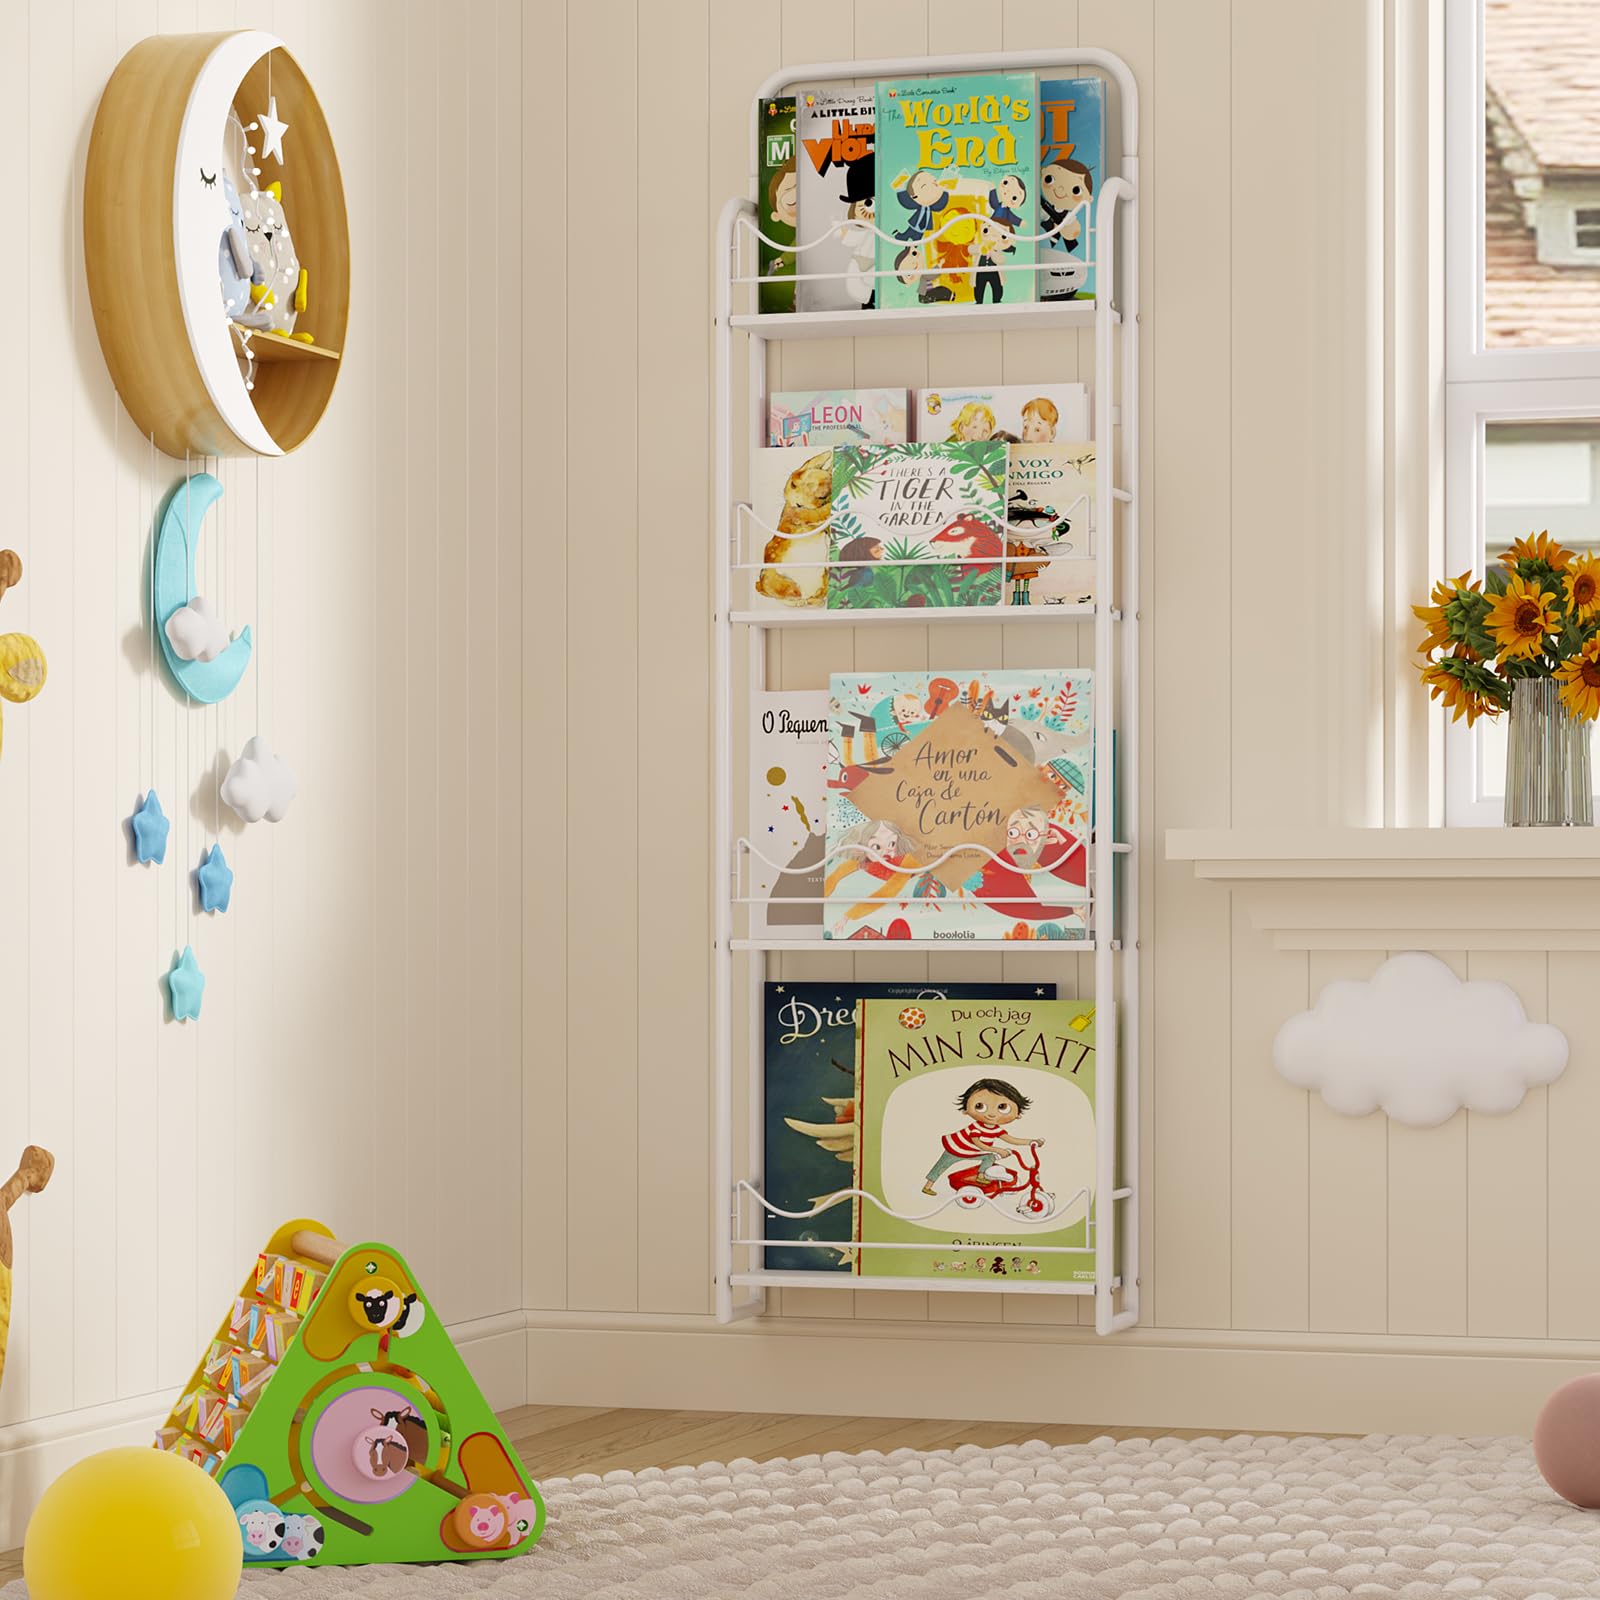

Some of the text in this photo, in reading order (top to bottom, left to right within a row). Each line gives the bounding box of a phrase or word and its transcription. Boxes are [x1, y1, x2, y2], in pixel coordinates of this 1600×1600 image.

[811, 110, 818, 118] A
[820, 108, 858, 118] LITTLE
[882, 95, 1030, 128] The World's
[832, 119, 875, 140] ULTR
[916, 125, 1019, 170] End
[811, 404, 862, 424] LEON
[890, 467, 933, 477] THERES
[1019, 459, 1053, 468] VOY
[875, 477, 954, 500] TIGER
[890, 501, 936, 511] IN THE
[762, 710, 774, 734] O
[914, 741, 978, 769] Amor
[933, 769, 992, 782] en una
[896, 780, 961, 808] Caja de
[919, 799, 1006, 835] Cartón
[952, 1007, 1032, 1025] Du och jag
[888, 1026, 1096, 1078] MIN SKATT
